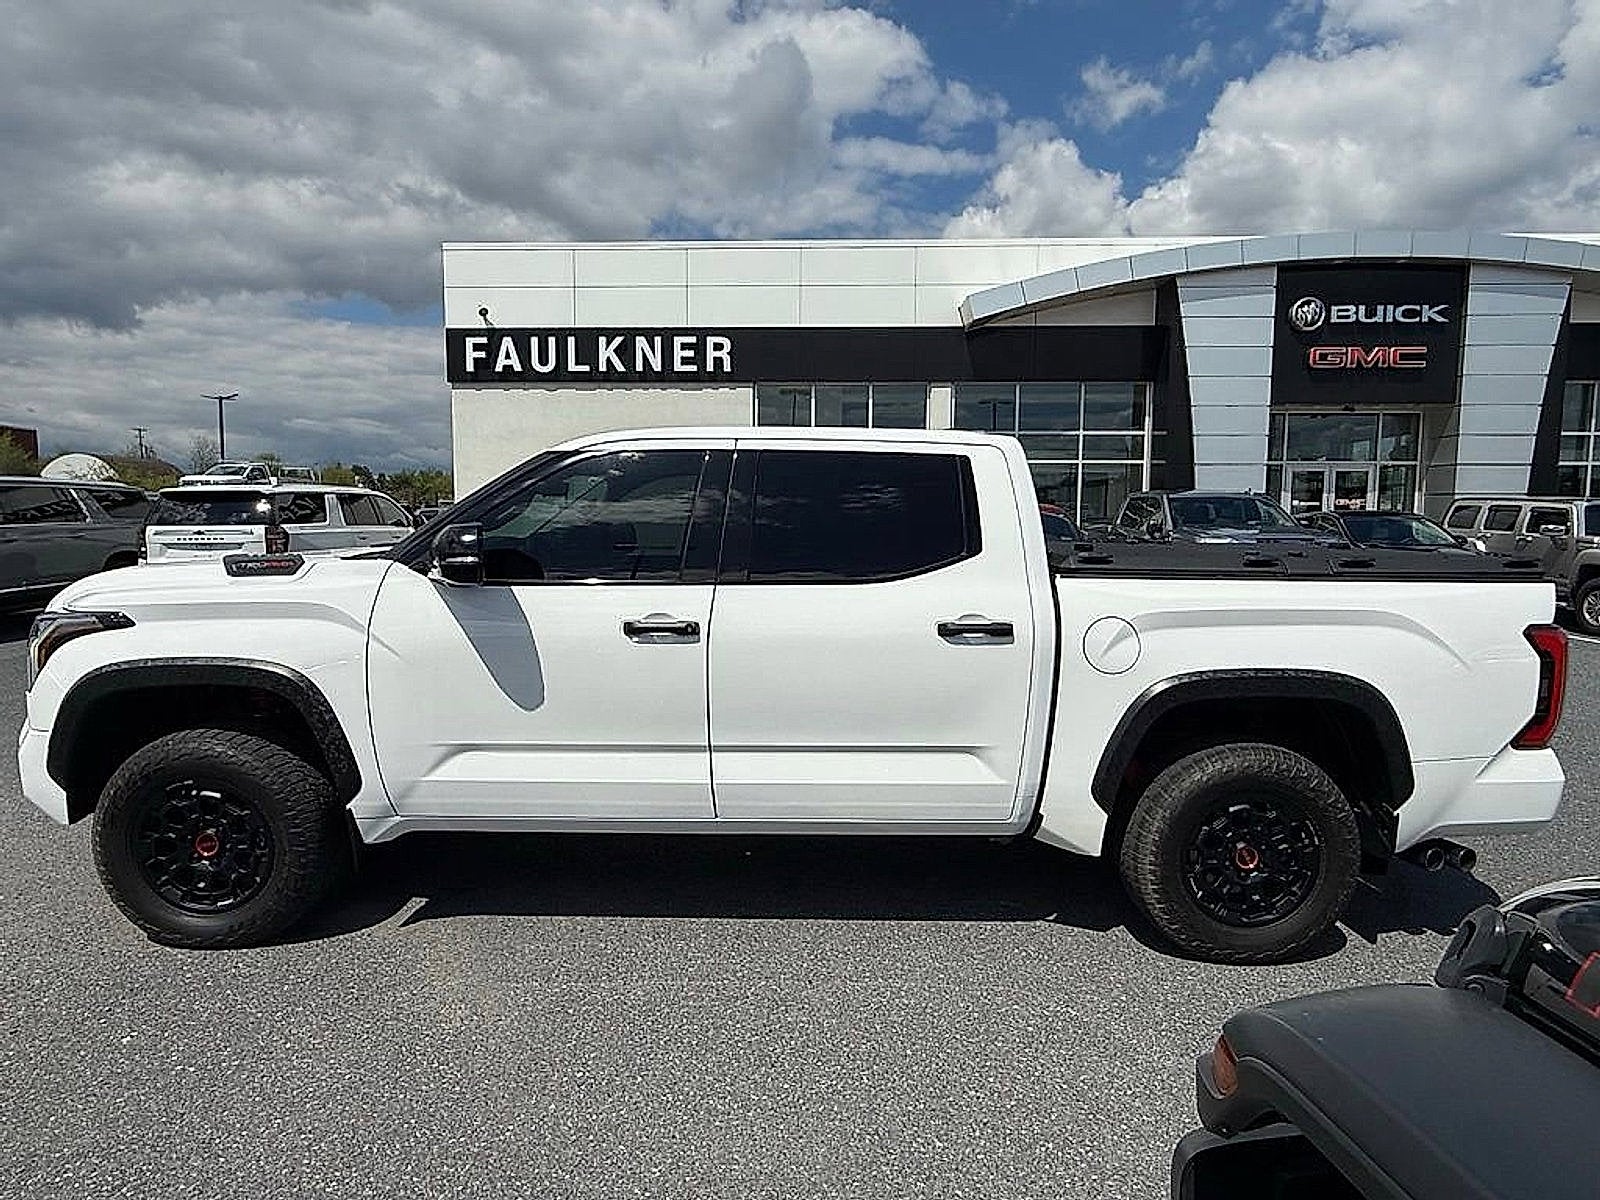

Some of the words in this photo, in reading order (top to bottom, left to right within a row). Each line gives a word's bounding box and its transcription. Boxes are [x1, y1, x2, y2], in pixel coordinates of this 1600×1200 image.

[1330, 304, 1450, 322] BUICK
[465, 336, 732, 372] FAULKNER
[1309, 346, 1428, 368] GMC
